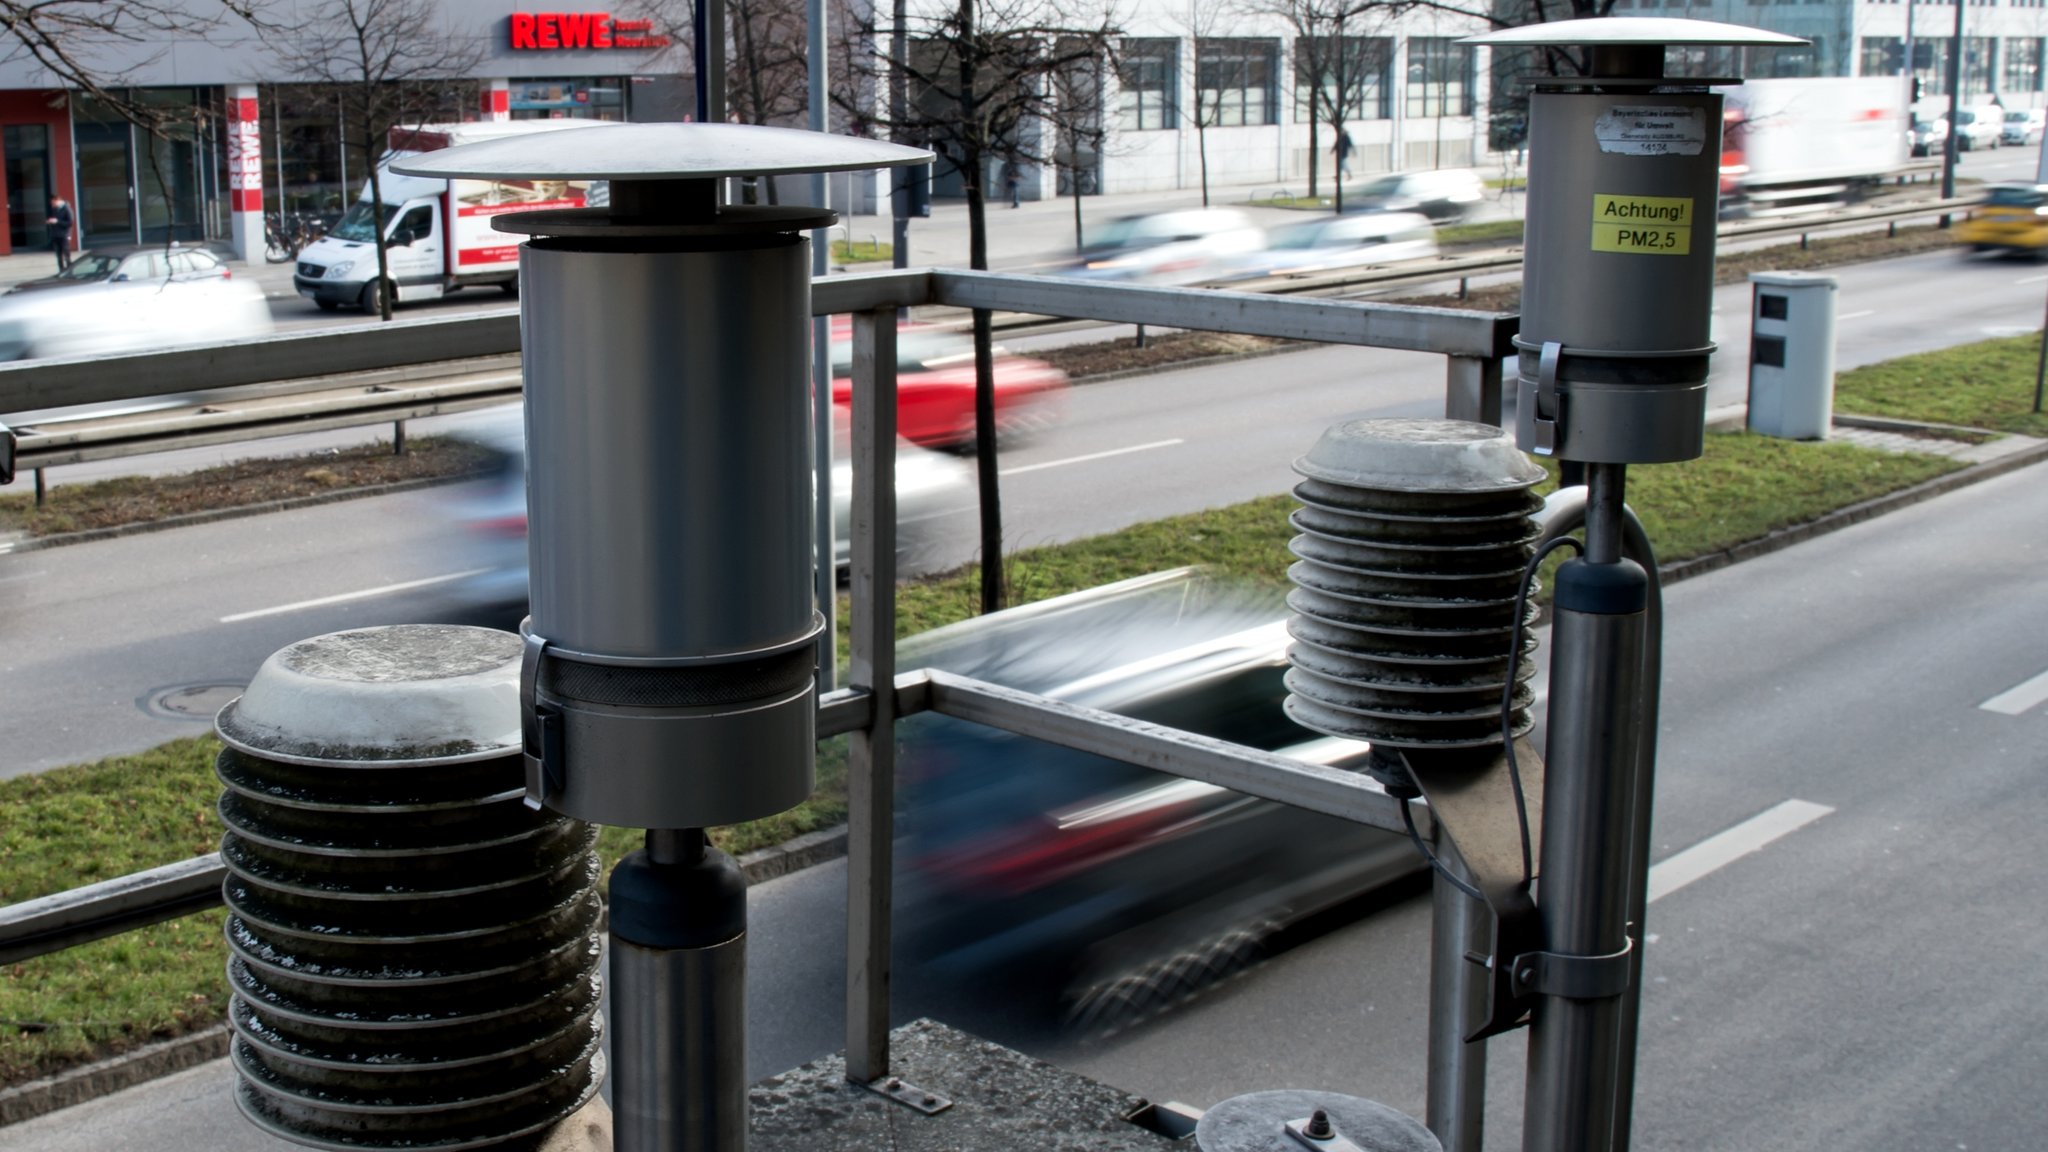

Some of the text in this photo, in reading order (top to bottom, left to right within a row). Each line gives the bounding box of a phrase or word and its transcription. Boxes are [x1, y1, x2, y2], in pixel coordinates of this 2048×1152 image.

[512, 12, 612, 49] REWE
[241, 120, 262, 189] REWE
[1604, 201, 1684, 222] Achtung!
[1617, 230, 1676, 250] PM2,5
